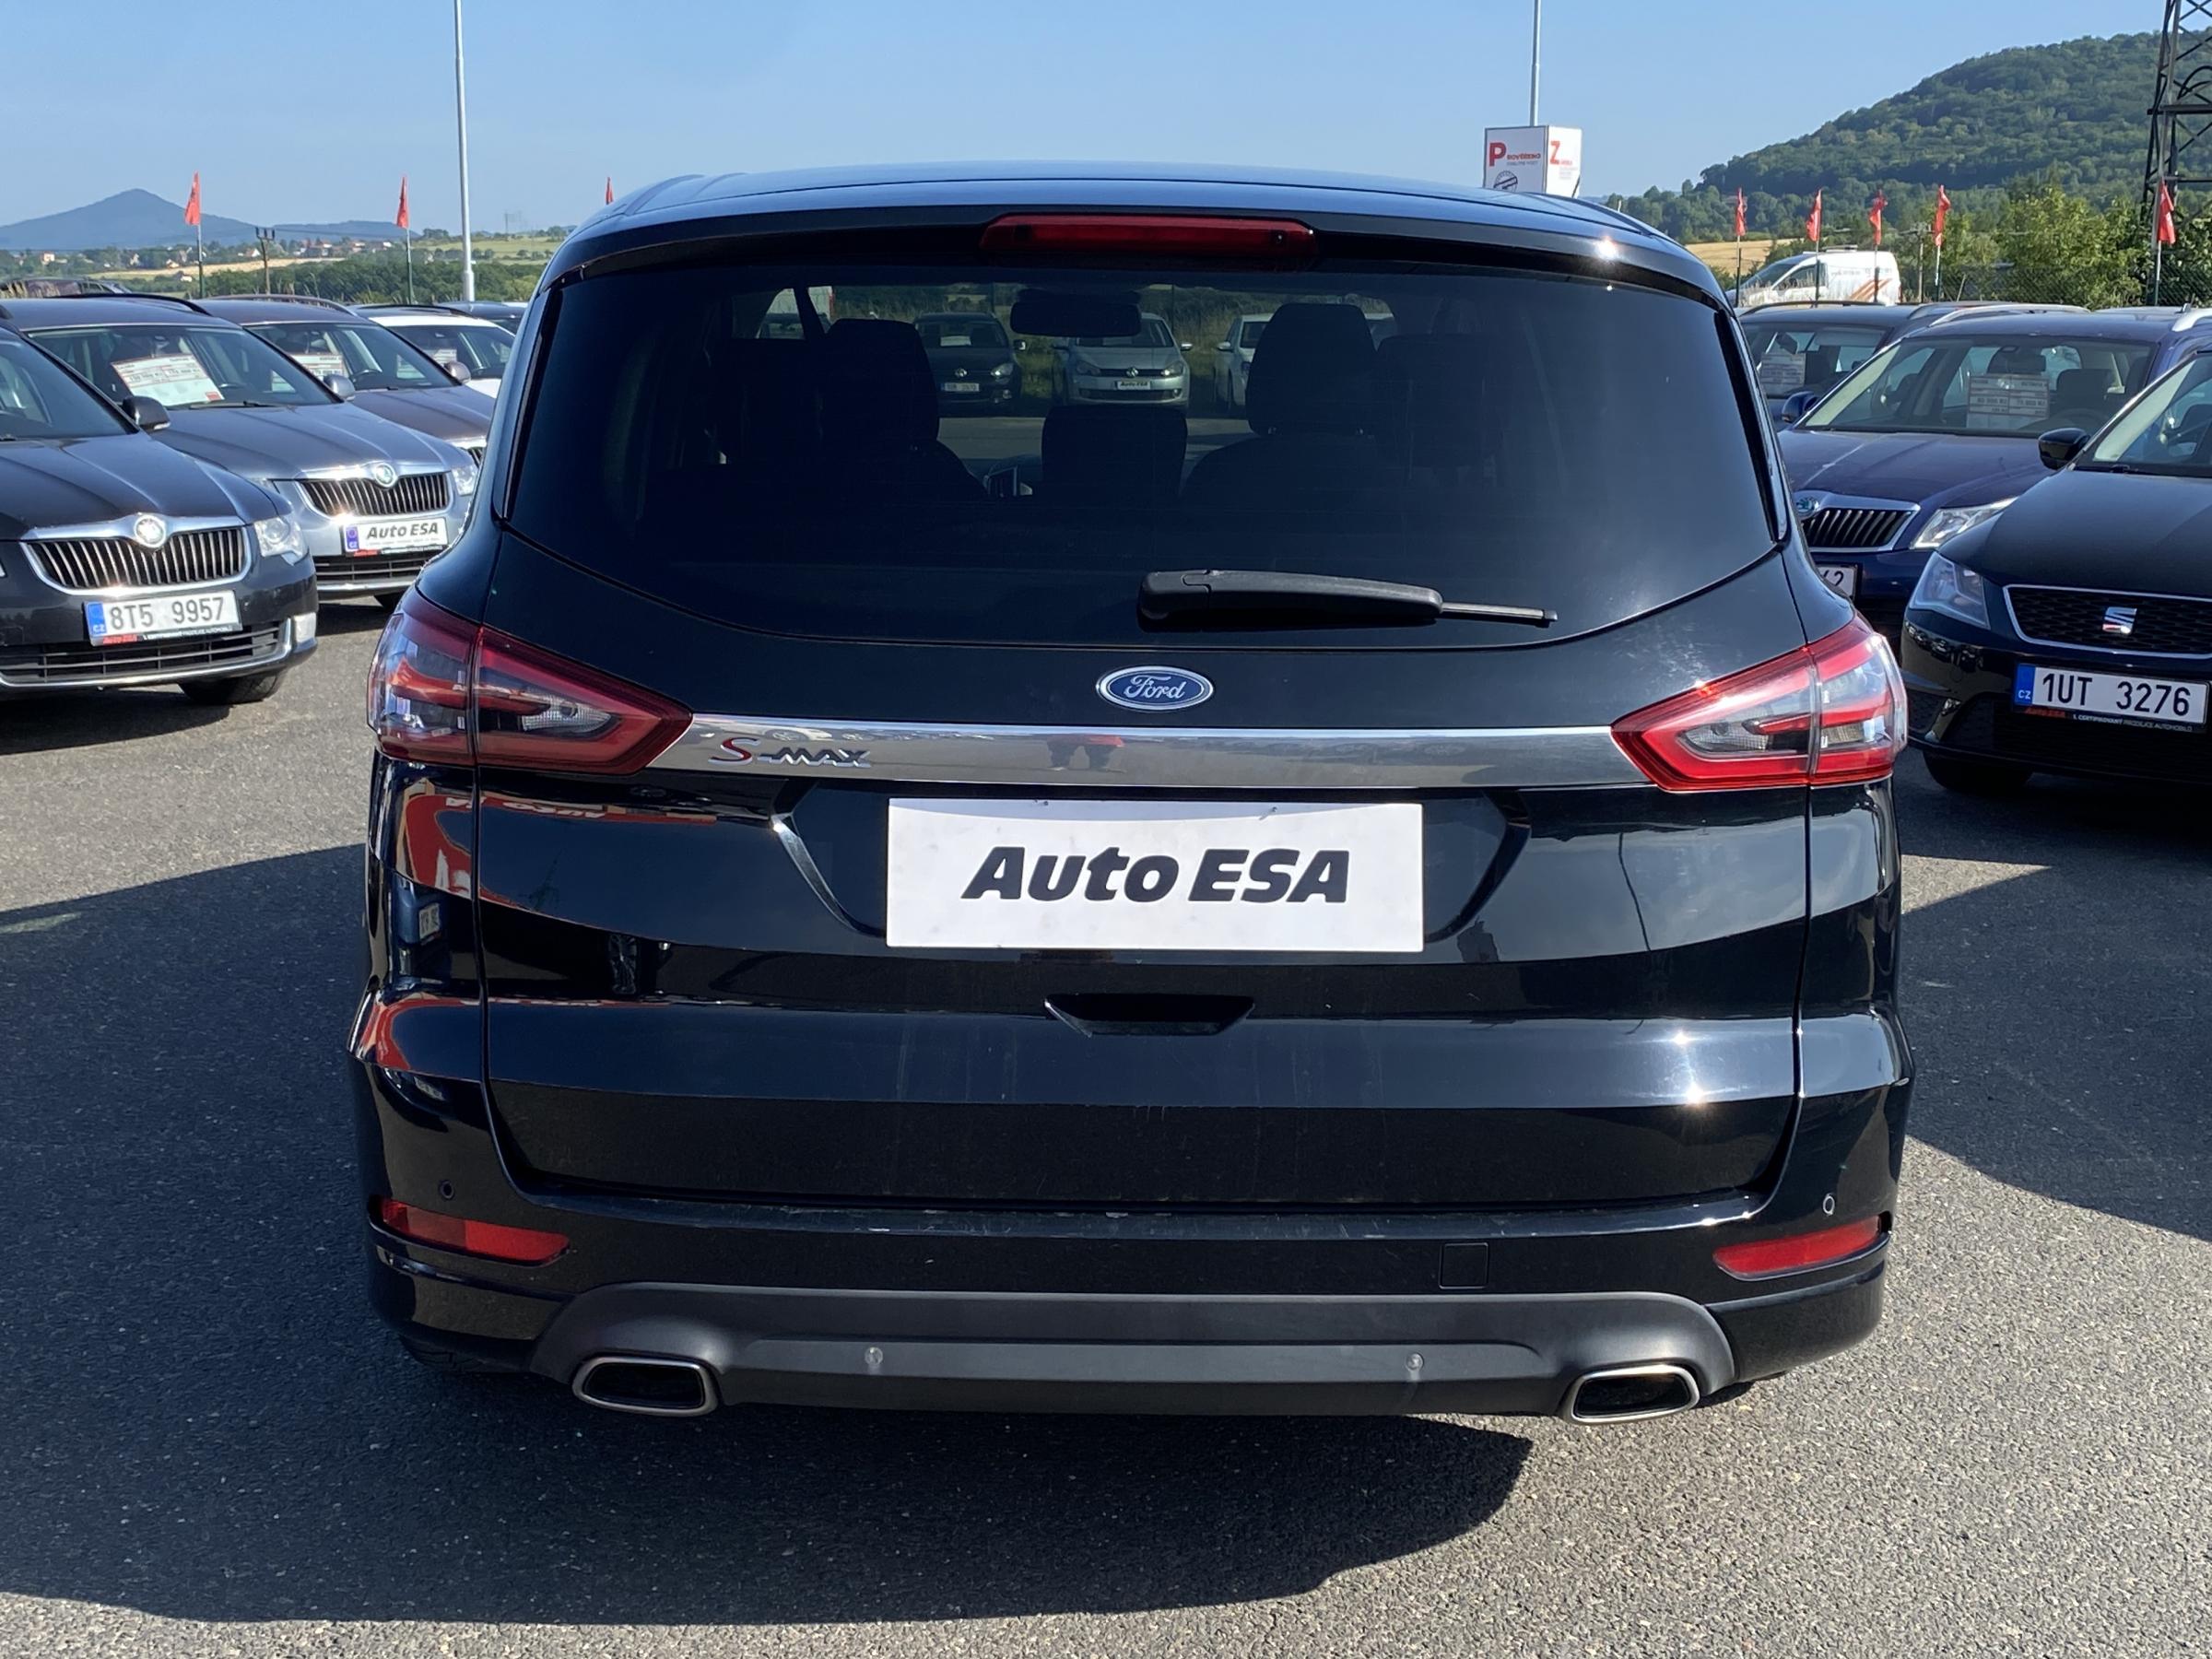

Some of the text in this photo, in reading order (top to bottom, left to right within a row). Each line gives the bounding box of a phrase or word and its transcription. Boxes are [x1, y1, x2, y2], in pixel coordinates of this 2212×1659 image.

[366, 522, 439, 539] Auto ESA
[111, 596, 224, 630] 8T5 9957
[93, 624, 105, 632] CZ
[1124, 675, 1187, 699] Ford
[2018, 689, 2031, 700] CZ
[2042, 673, 2191, 716] 1UT 3276
[960, 845, 1350, 903] Auto ESA
